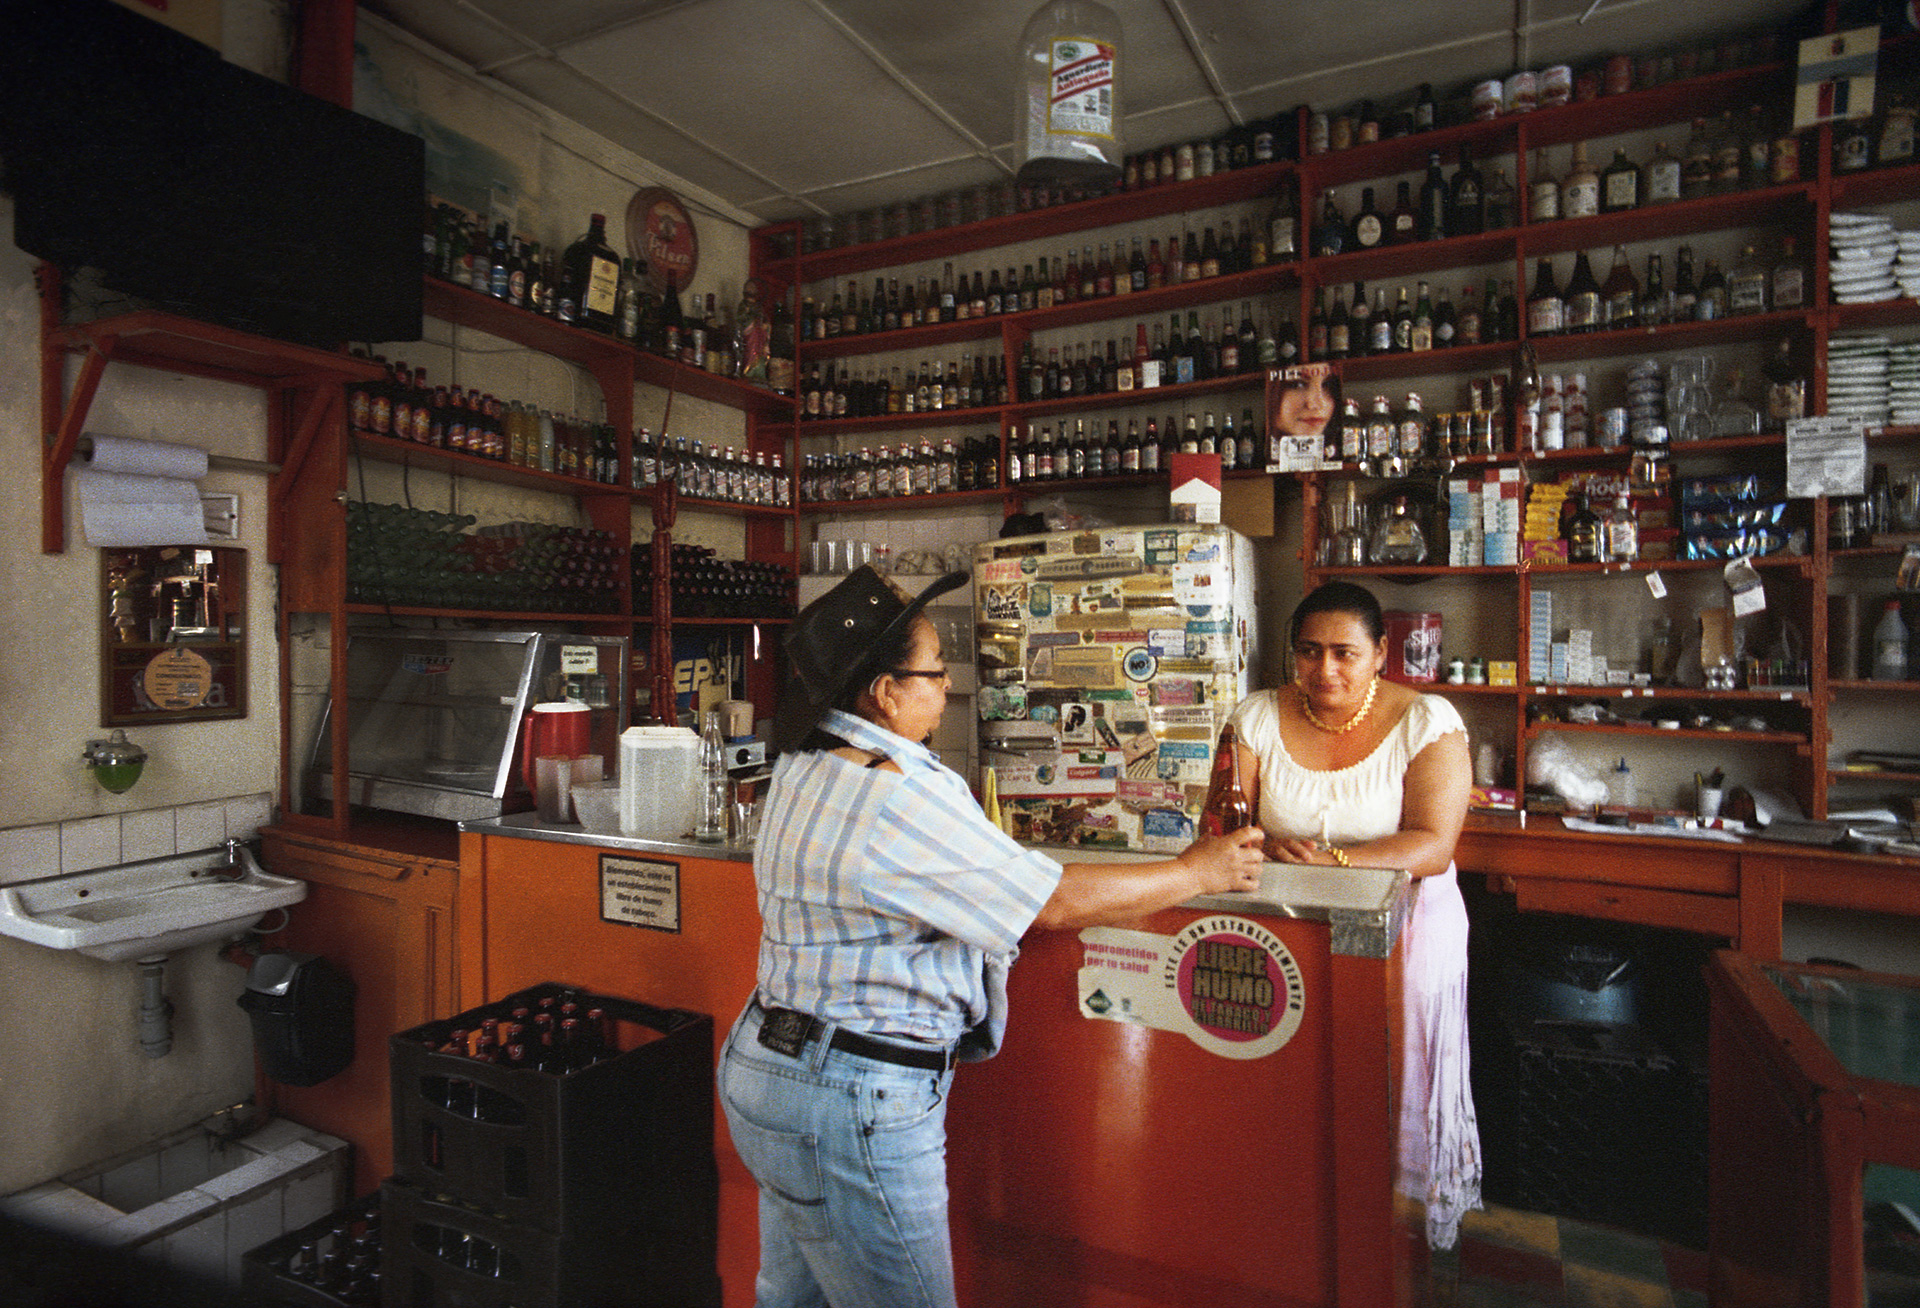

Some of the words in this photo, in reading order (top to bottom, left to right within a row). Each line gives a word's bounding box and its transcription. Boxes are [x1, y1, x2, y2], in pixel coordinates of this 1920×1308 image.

[647, 872, 662, 880] este
[617, 881, 671, 895] establecimiento
[616, 893, 631, 902] libre
[632, 895, 641, 903] de
[642, 896, 663, 906] humo
[621, 906, 630, 914] de
[1083, 943, 1159, 961] omprometidos
[1188, 924, 1206, 939] UN
[1211, 920, 1301, 1011] ESTABLECIMIENTO
[1196, 940, 1268, 979] LIBRE
[1119, 961, 1149, 974] salud
[1191, 968, 1275, 1011] HUMO
